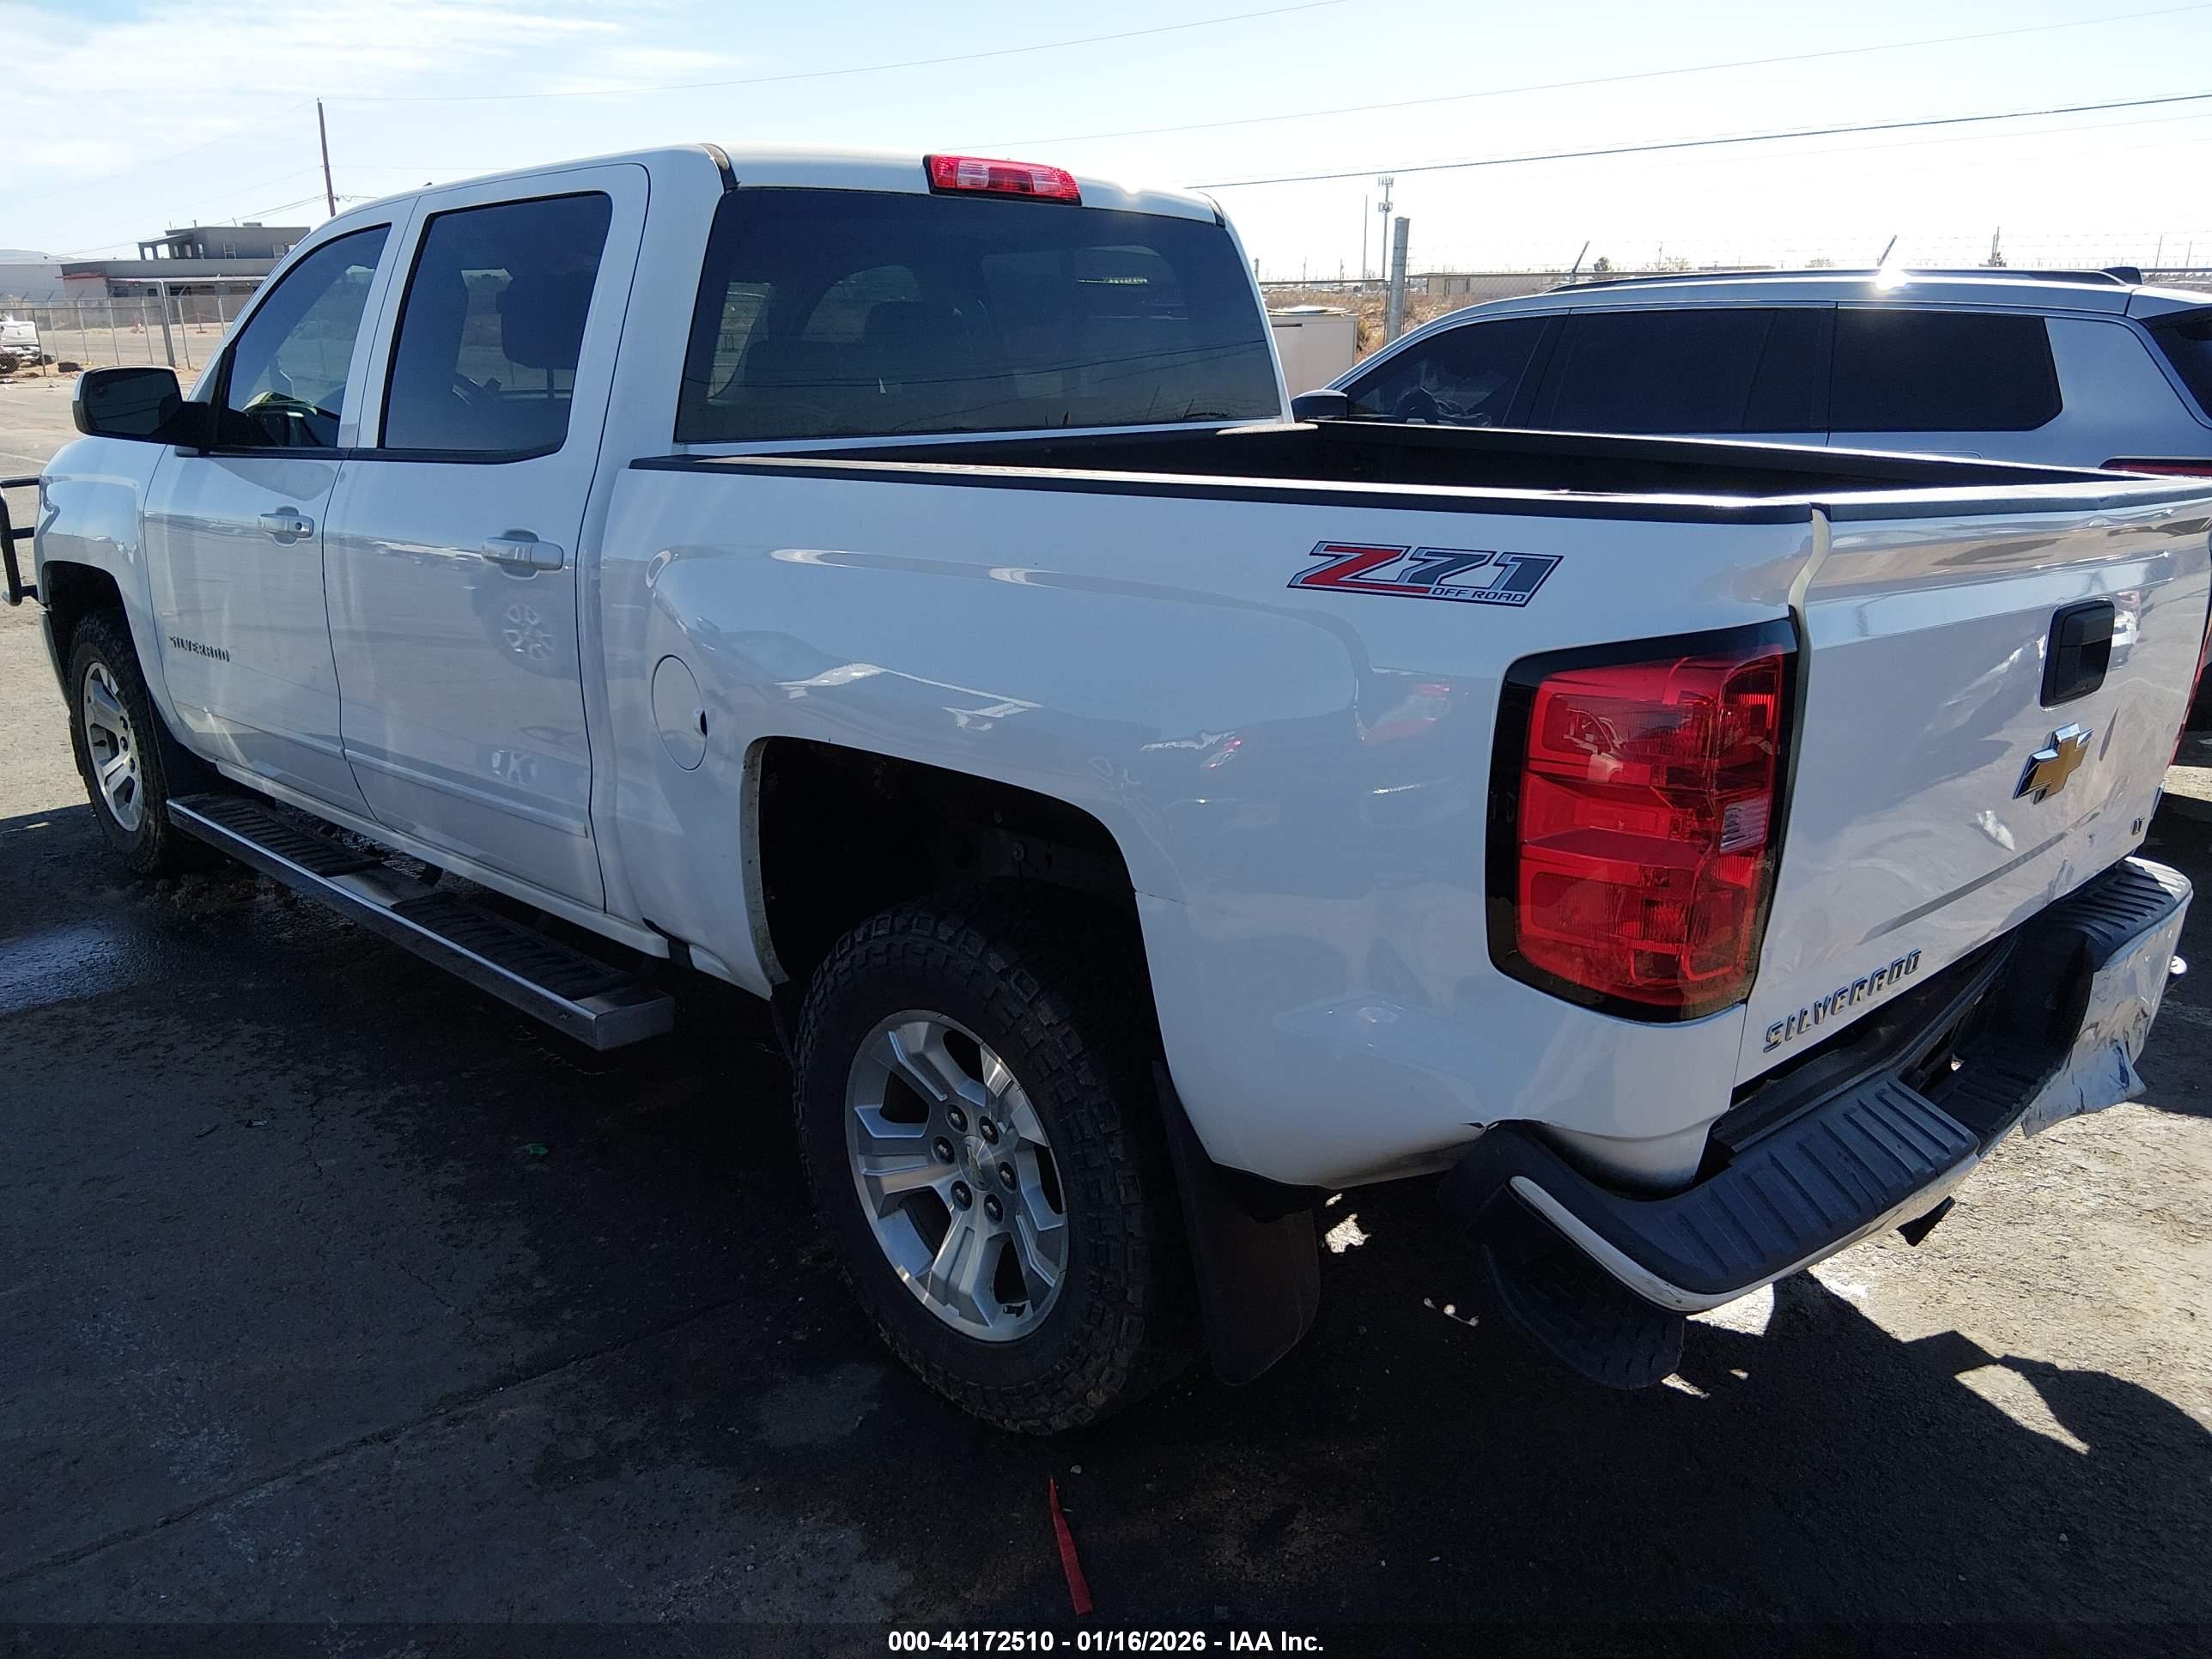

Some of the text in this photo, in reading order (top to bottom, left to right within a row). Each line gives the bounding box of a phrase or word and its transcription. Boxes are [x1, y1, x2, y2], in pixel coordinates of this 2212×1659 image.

[1287, 541, 1564, 607] Z71
[1431, 588, 1526, 602] OFF ROAD
[169, 636, 230, 662] SILVERADO
[1764, 948, 1922, 1052] SILVERADO
